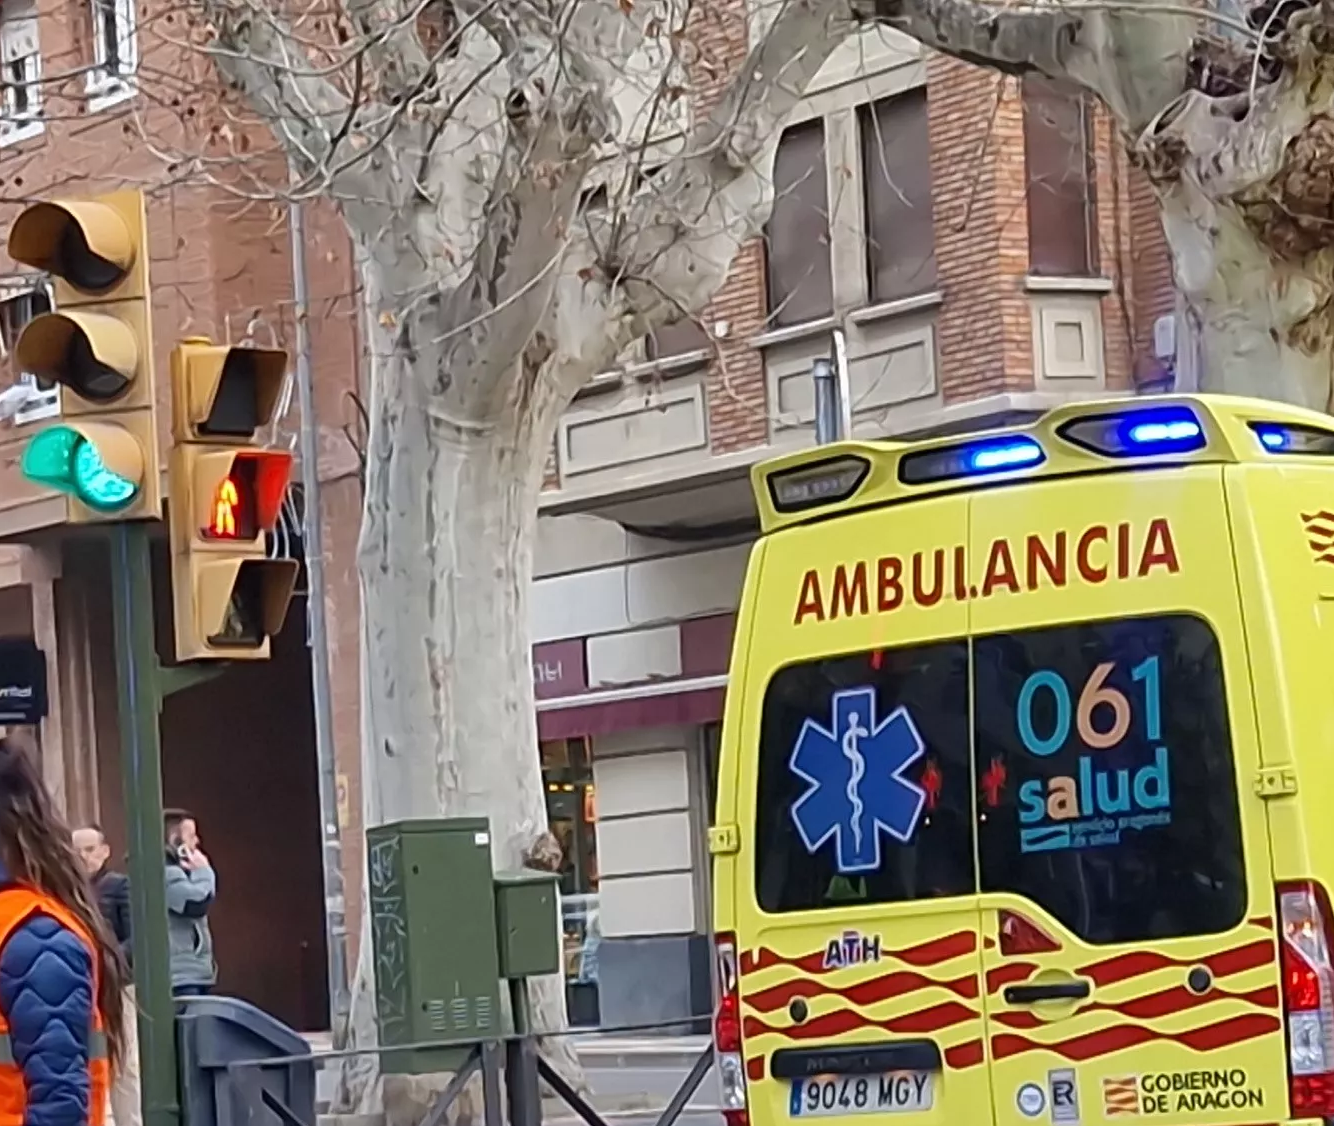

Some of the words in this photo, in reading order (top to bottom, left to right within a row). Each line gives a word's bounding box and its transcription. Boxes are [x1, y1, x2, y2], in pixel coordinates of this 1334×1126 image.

[793, 517, 1180, 626] AMBULANCIA
[1018, 656, 1161, 756] 061
[1019, 747, 1171, 823] salud
[824, 932, 881, 967] ATH
[806, 1077, 868, 1111] 9048
[877, 1074, 928, 1106] MGY
[1141, 1069, 1246, 1093] GOBIERNO
[1142, 1096, 1169, 1114] DE
